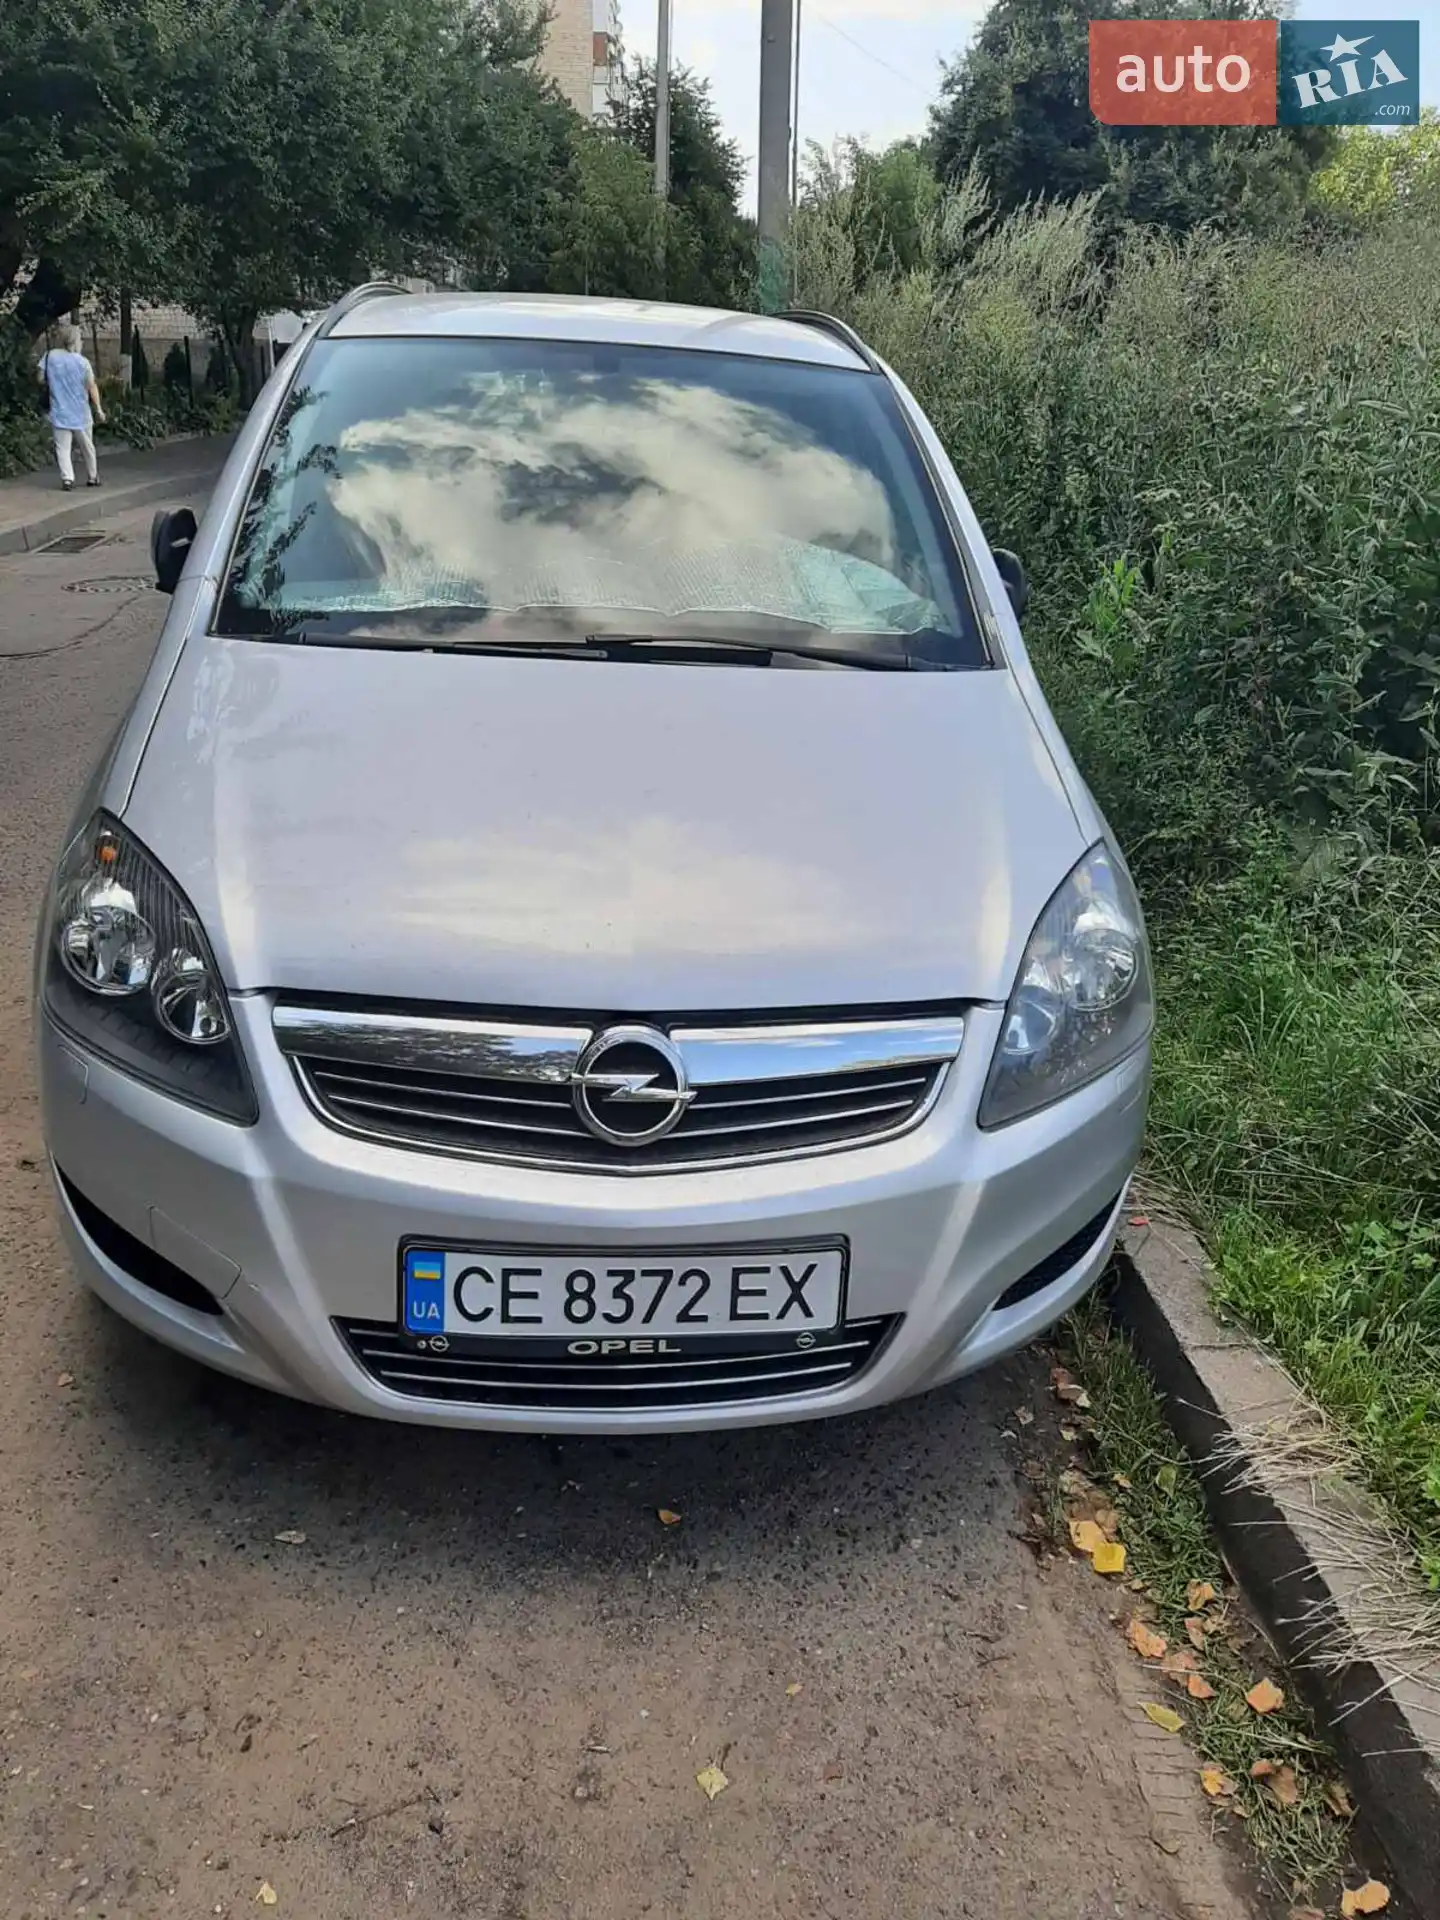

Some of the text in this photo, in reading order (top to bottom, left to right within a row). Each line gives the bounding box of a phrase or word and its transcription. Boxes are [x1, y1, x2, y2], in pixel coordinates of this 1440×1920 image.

[453, 1263, 818, 1325] CE 8372 EX
[411, 1301, 441, 1320] UA
[567, 1338, 682, 1355] OPEL
